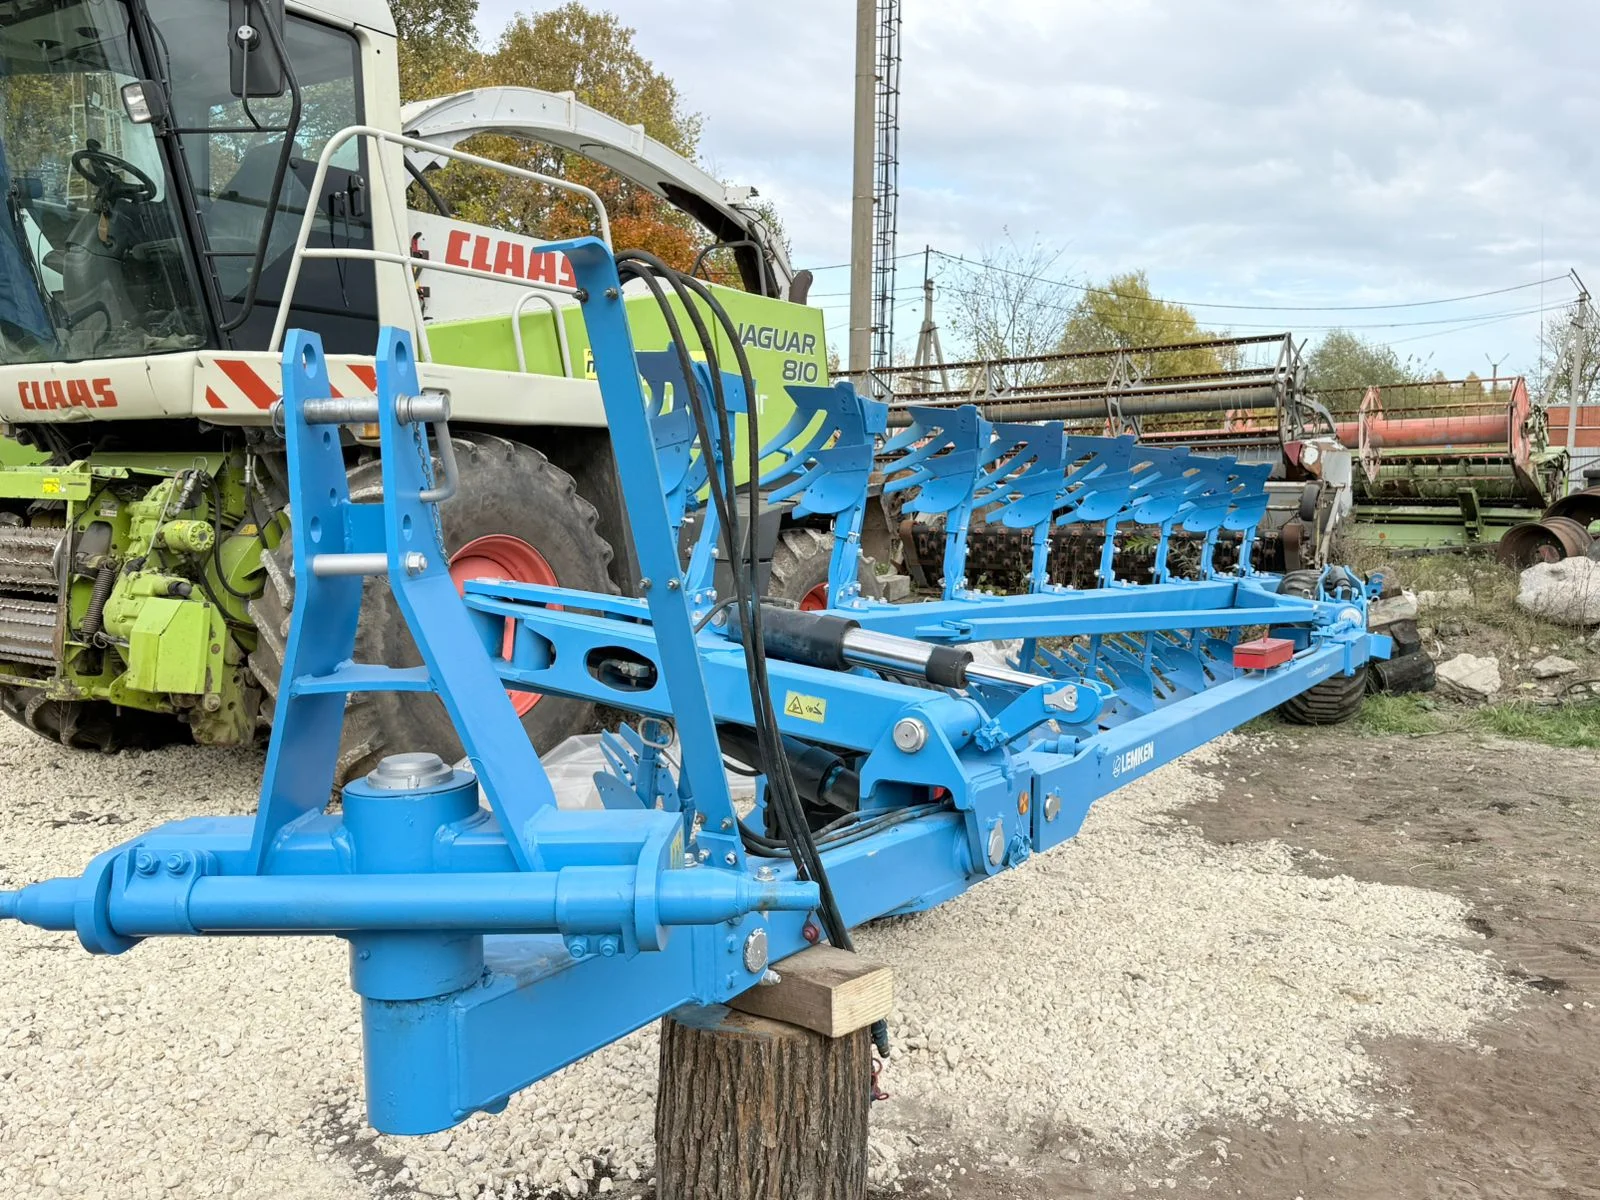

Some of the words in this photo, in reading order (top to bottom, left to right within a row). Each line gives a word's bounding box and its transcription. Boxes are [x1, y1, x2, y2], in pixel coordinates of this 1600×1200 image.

[782, 359, 818, 384] 810
[17, 378, 118, 410] CLAAS
[1121, 740, 1154, 773] LEMKEN
